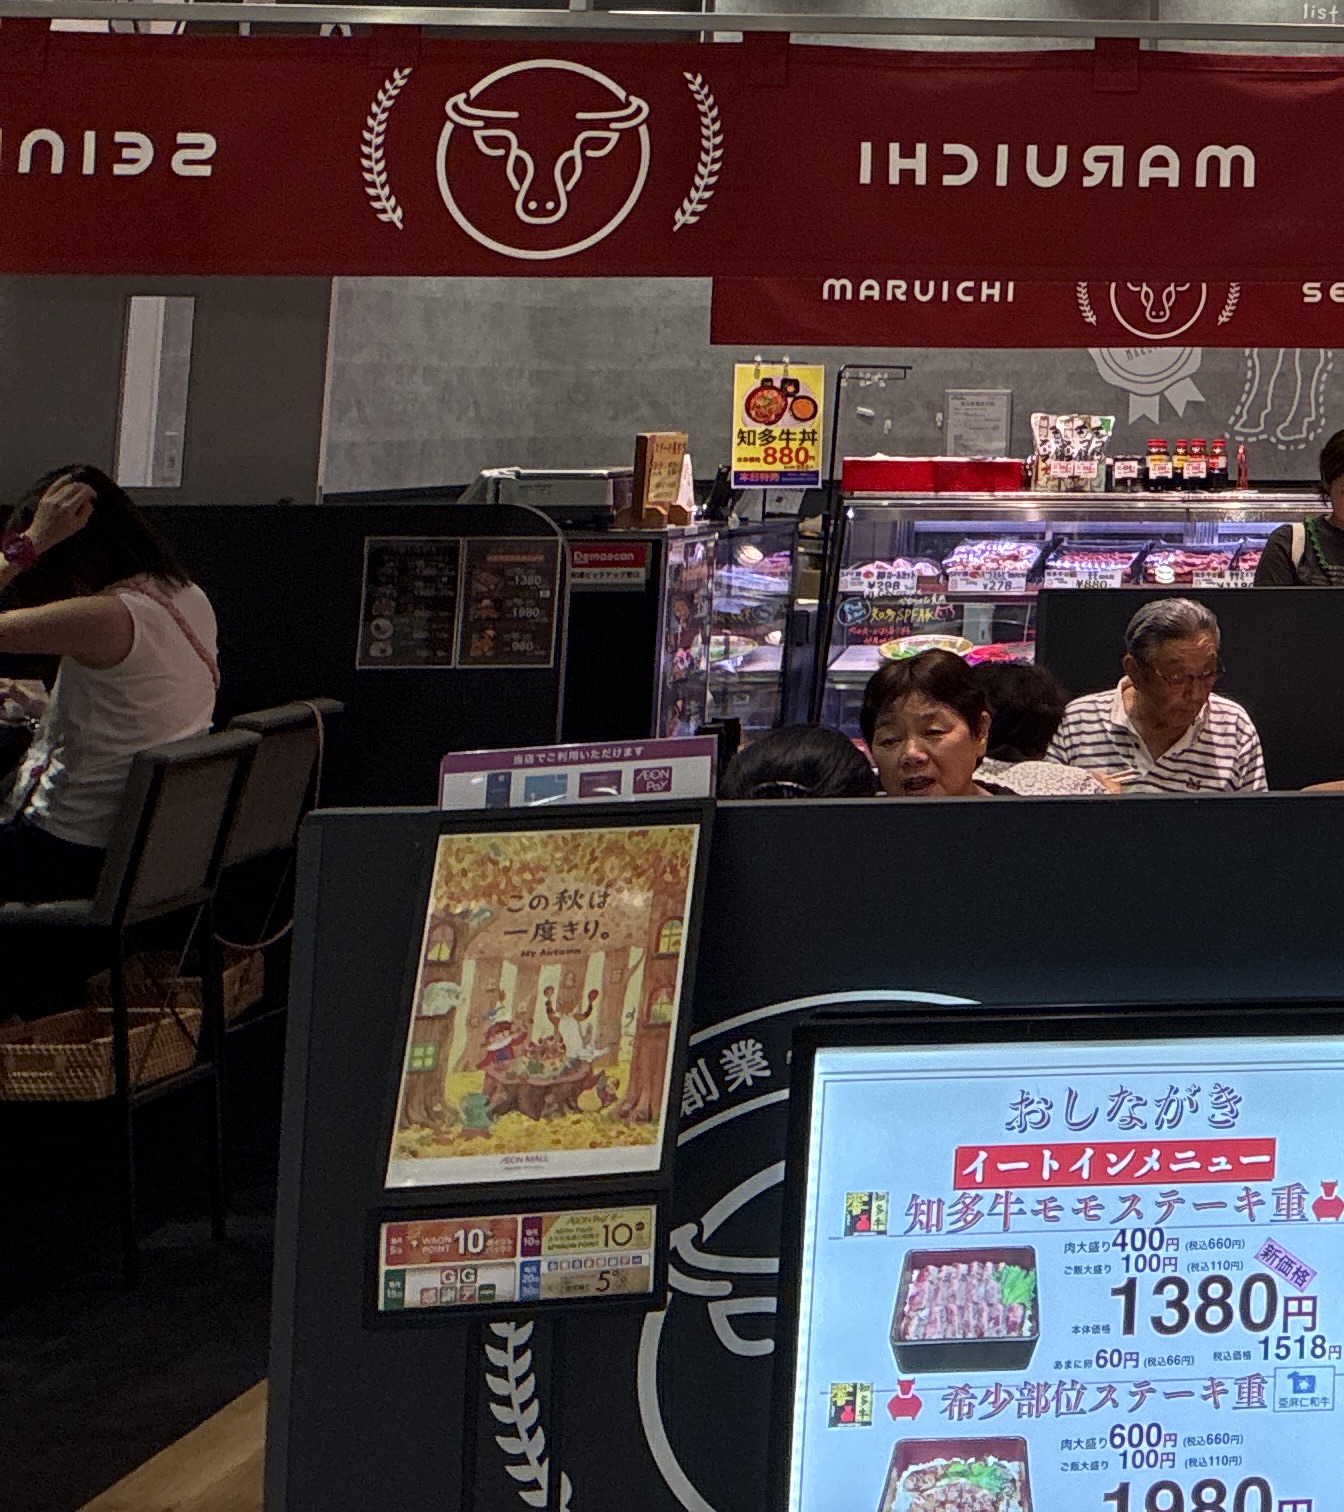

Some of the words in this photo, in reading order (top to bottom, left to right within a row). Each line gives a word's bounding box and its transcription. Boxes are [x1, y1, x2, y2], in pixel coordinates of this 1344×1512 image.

[1303, 2, 1339, 24] list
[821, 277, 1015, 303] MARUICHI
[737, 428, 818, 446] 知多牛丼
[513, 745, 645, 766] 当店でご利用いただけます
[507, 889, 610, 912] この秋は
[1004, 1082, 1244, 1131] おしながき
[961, 1147, 1273, 1184] イートインメニュー
[904, 1182, 1310, 1234] 知多牛モモステーキ重
[1258, 1242, 1312, 1290] 新価格
[940, 1373, 1268, 1422] 希少部位ステーキ重
